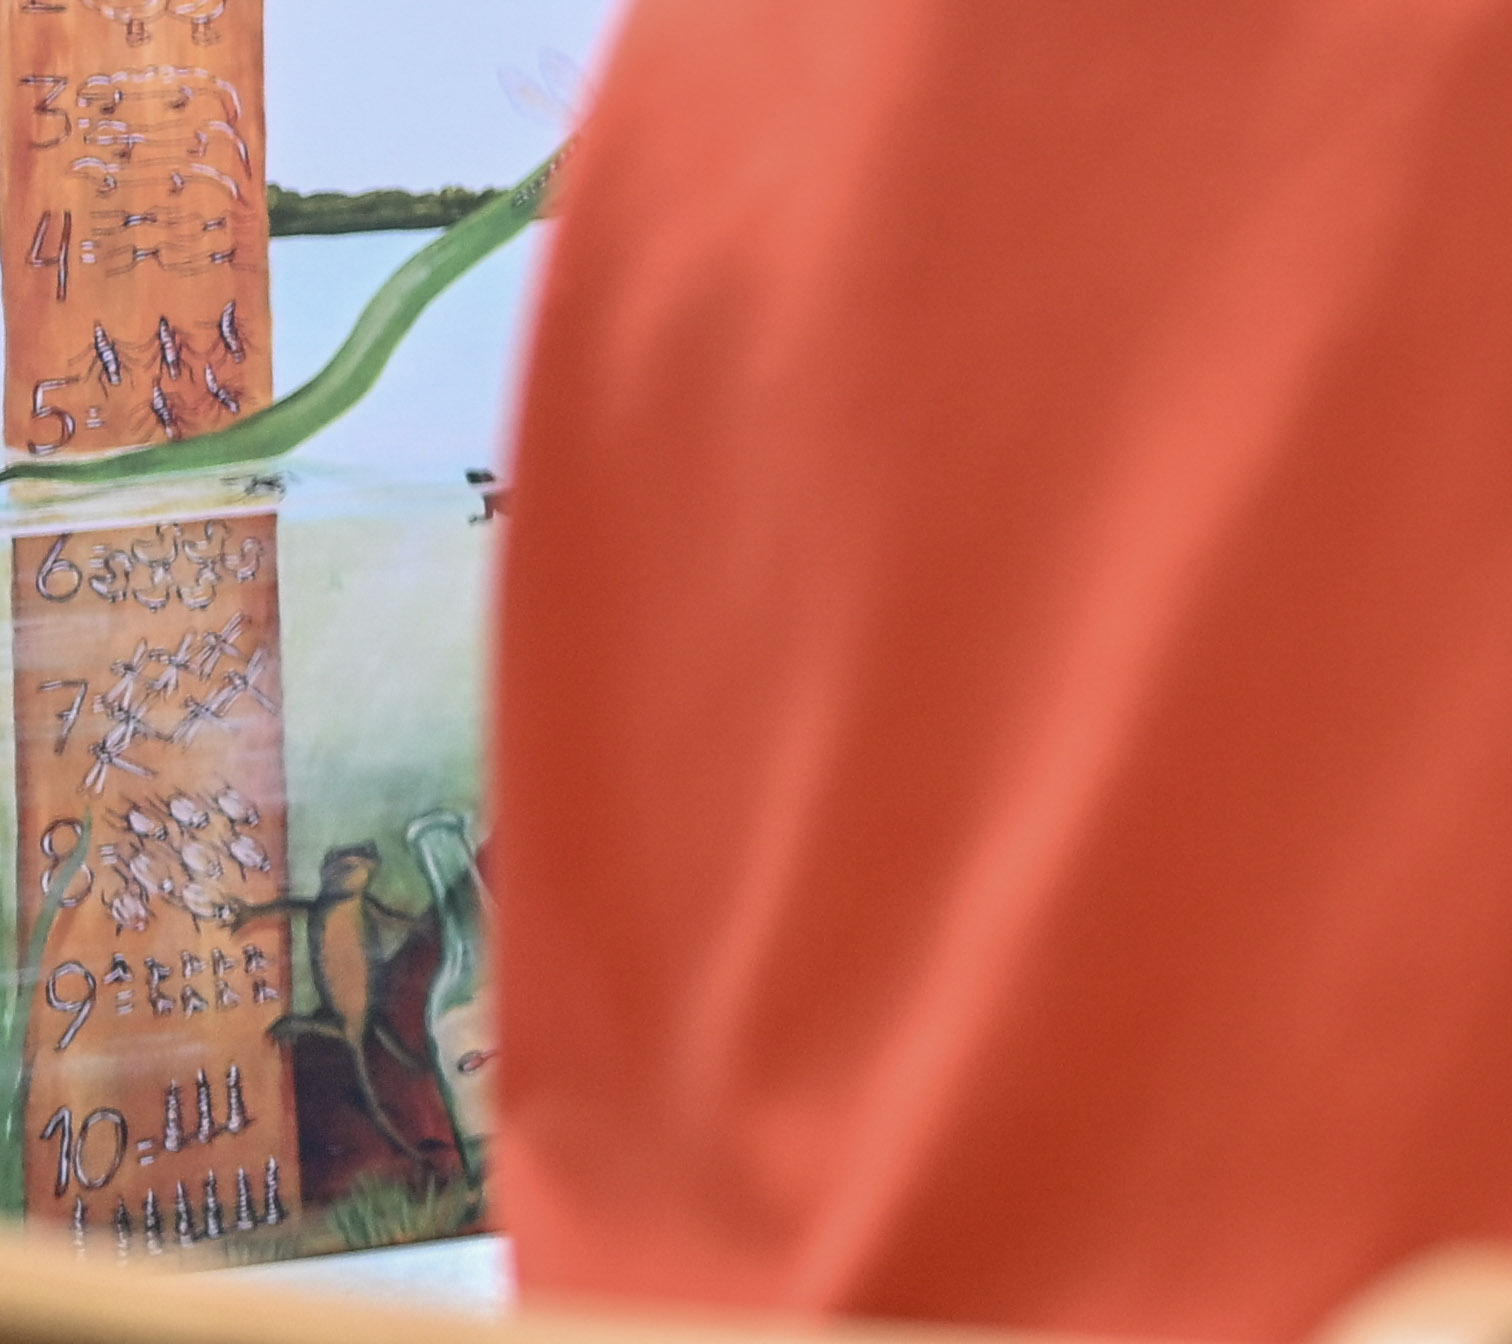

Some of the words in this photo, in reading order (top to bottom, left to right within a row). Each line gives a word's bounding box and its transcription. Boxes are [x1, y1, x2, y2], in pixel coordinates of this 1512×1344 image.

[19, 73, 72, 150] 3
[28, 209, 72, 302] 4
[28, 376, 80, 455] 5
[36, 532, 83, 604] 6
[39, 679, 88, 755] 7
[41, 817, 94, 908] 8
[46, 961, 97, 1052] 9
[40, 1106, 129, 1199] 10
